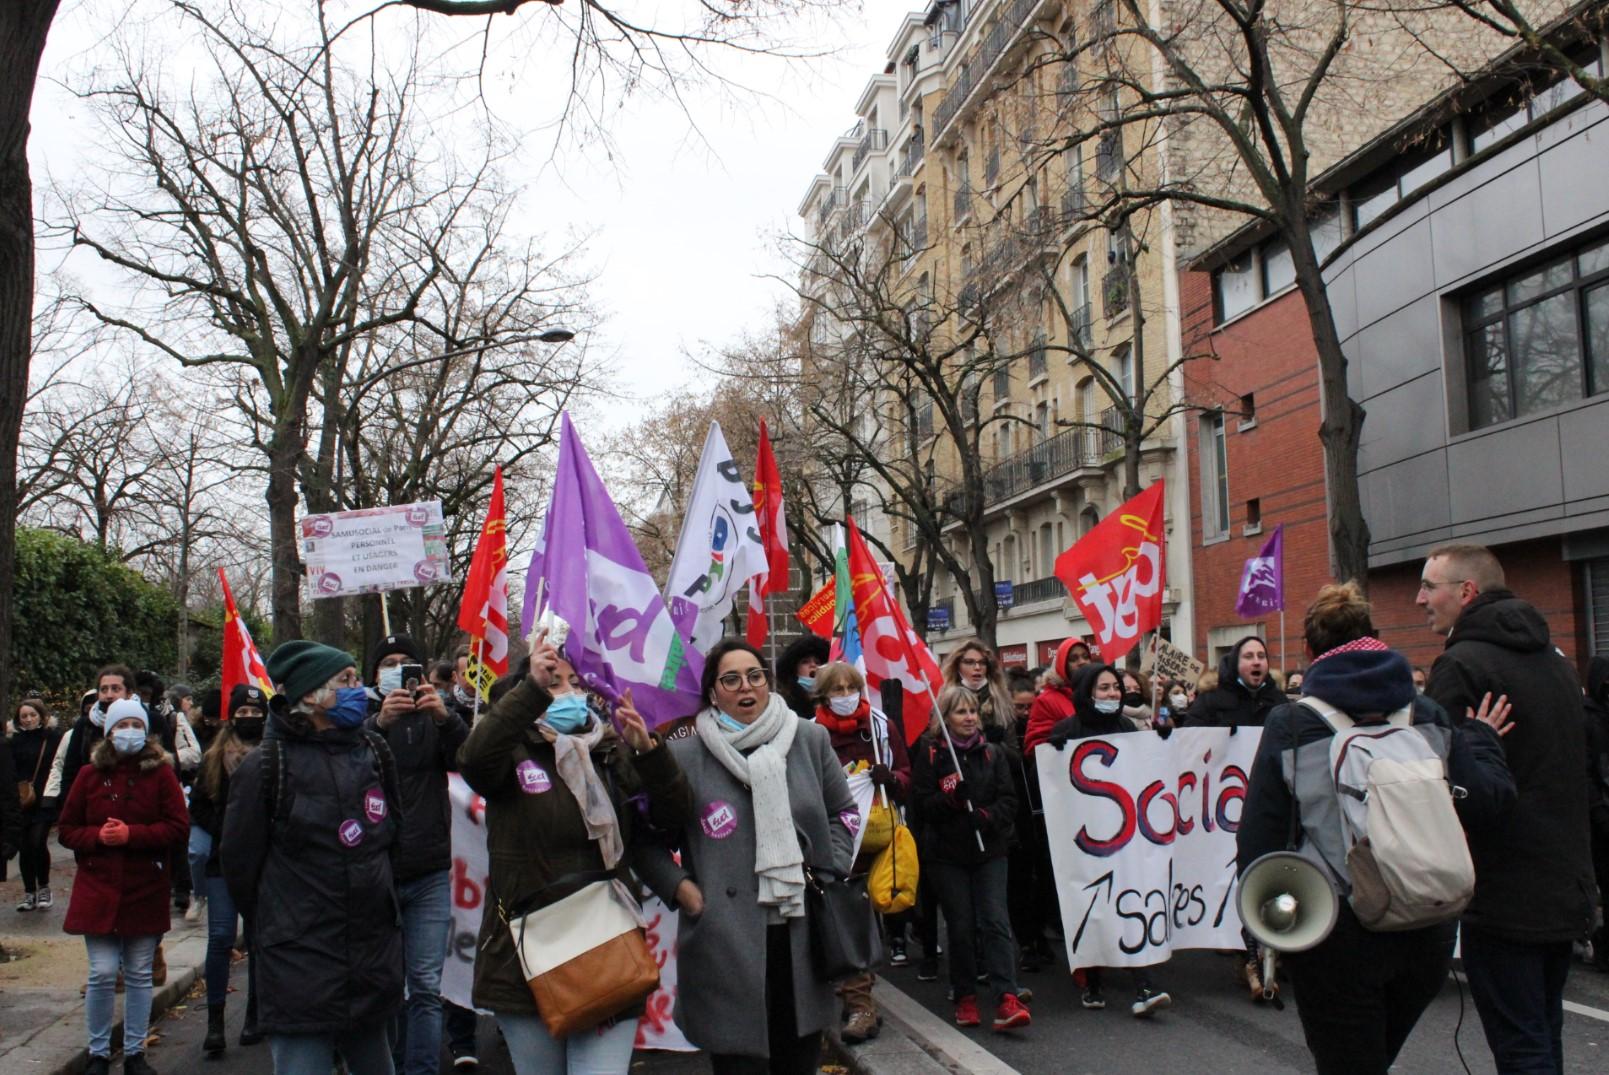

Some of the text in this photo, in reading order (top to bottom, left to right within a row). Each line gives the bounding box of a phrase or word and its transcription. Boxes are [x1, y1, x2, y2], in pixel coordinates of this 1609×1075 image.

[331, 527, 382, 538] SAMUSOCIAL
[351, 538, 396, 549] PERSONNEL
[363, 551, 398, 561] USAGERS
[366, 562, 399, 573] DANGER
